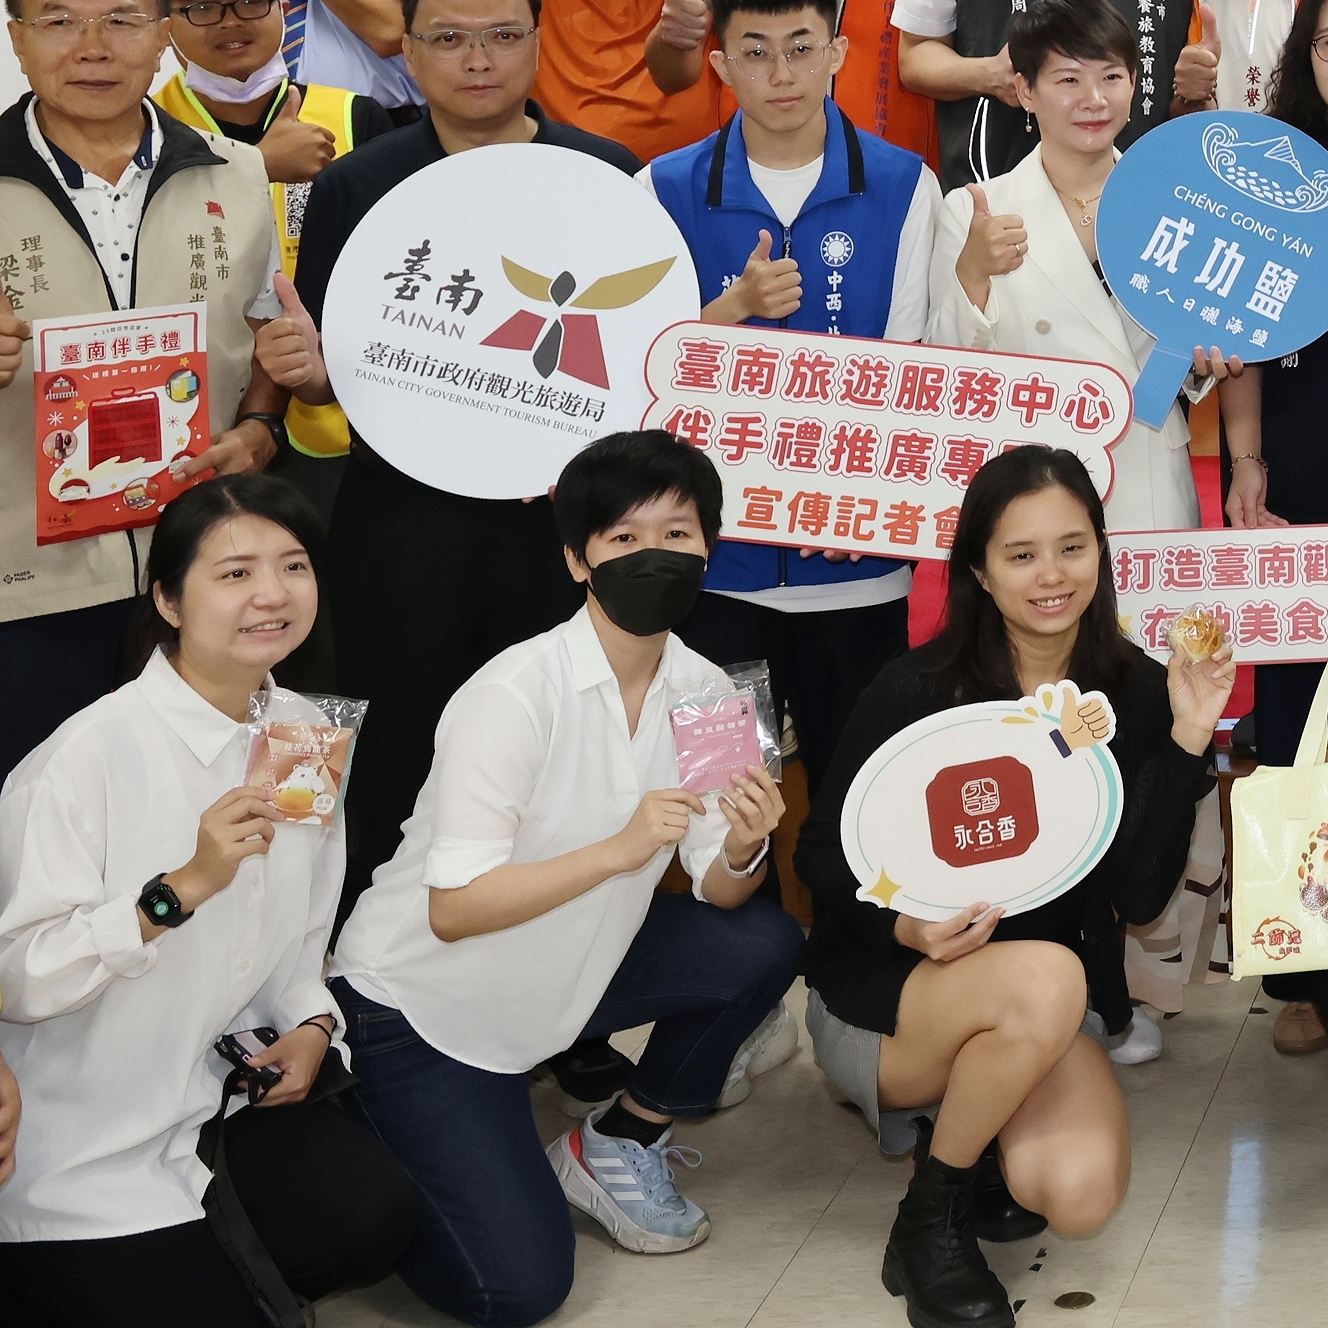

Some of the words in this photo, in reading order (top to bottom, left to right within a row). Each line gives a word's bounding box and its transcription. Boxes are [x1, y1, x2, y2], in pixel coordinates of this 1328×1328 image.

[1243, 65, 1262, 108] 榮譽
[211, 226, 230, 281] 臺南市
[1230, 211, 1279, 243] GONG
[1281, 233, 1315, 259] YÁN
[20, 234, 51, 294] 理事長
[383, 239, 484, 316] 臺南
[1140, 215, 1300, 323] 成功鹽
[60, 331, 182, 365] 臺南伴手禮
[380, 303, 466, 340] TAINAN
[354, 368, 401, 387] TAINAN
[396, 379, 424, 395] CITY
[425, 387, 503, 414] GOVERNMENT
[502, 407, 551, 428] TOURISM
[552, 421, 598, 440] BUREAU
[360, 340, 607, 423] 臺南市政府觀光旅遊局
[671, 339, 1114, 433] 臺南旅遊服務中心
[664, 407, 1039, 488] 伴手禮推廣專
[953, 815, 1016, 851] 永合香
[1250, 928, 1303, 947] 二師兄
